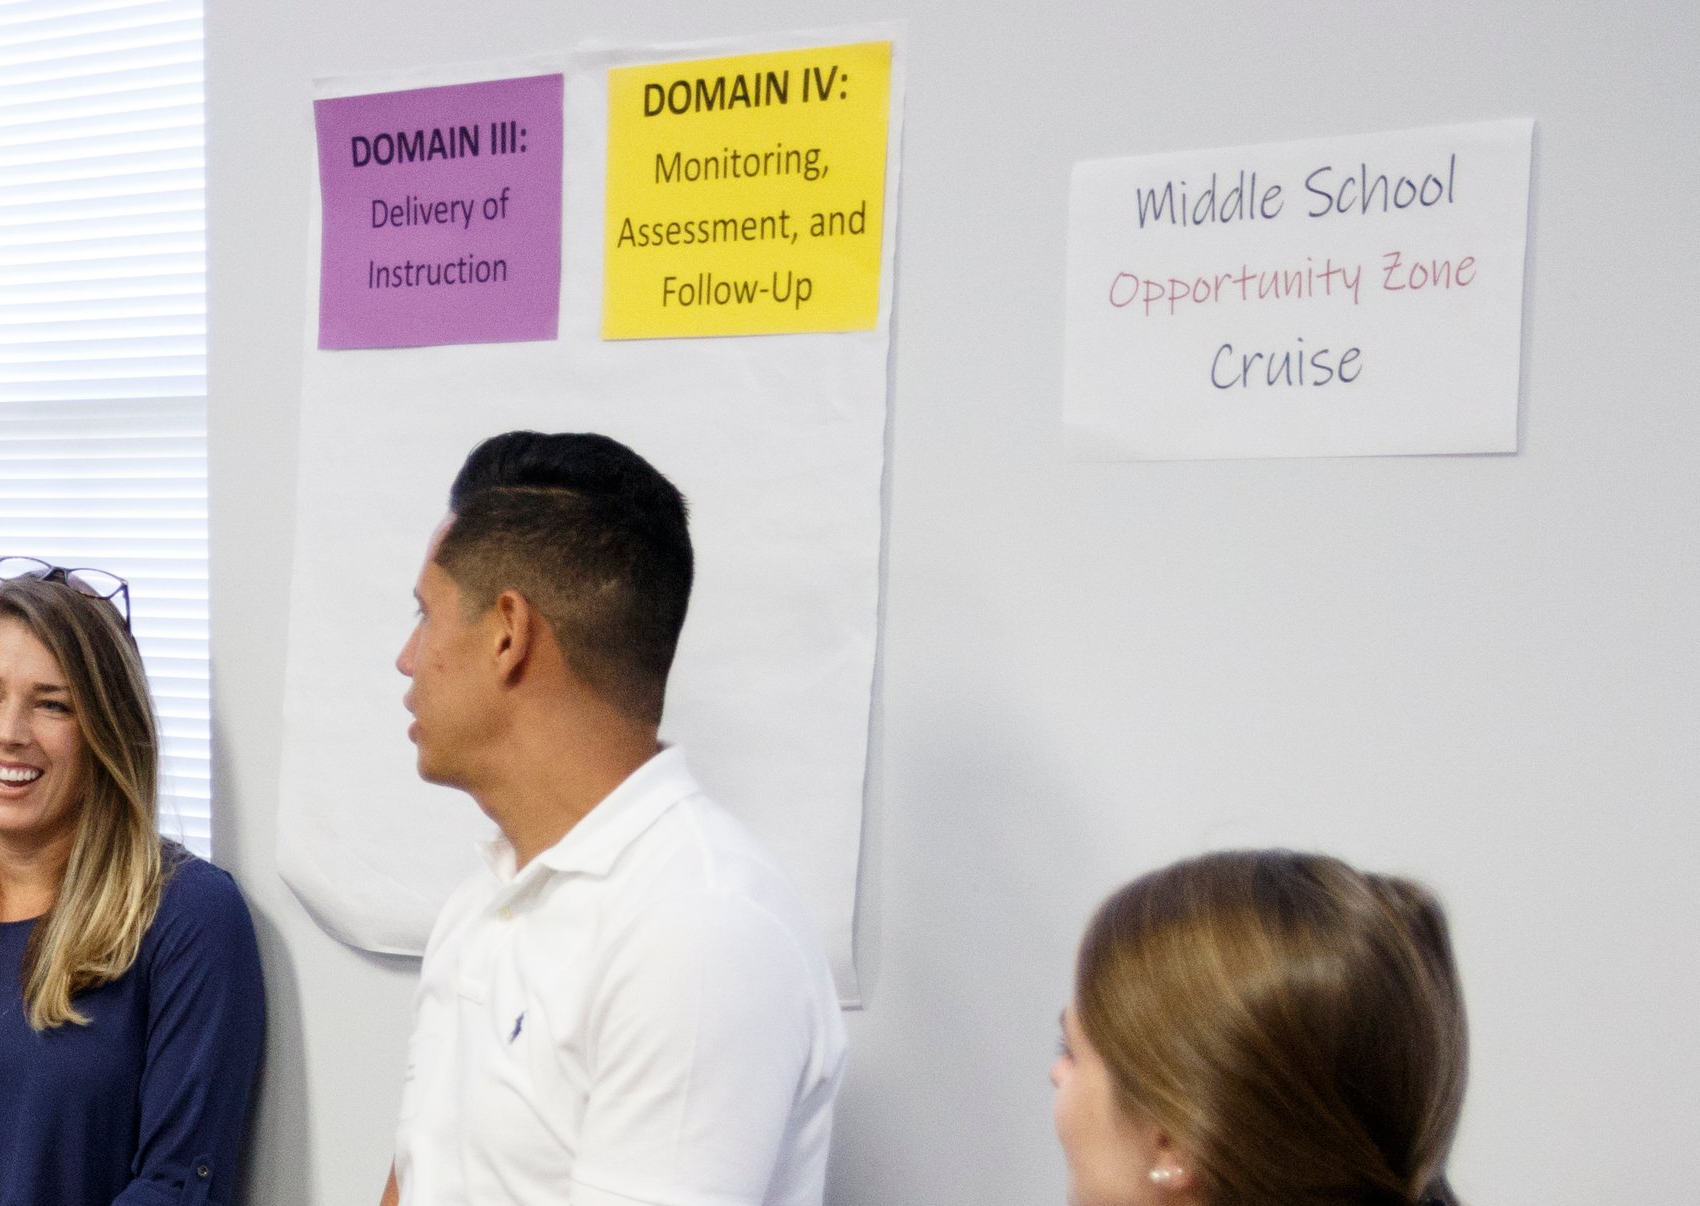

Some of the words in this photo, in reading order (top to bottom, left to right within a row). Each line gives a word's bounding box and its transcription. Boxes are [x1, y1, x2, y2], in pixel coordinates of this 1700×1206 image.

[643, 70, 790, 117] DOMAIN
[801, 64, 849, 104] IV:
[351, 124, 481, 168] DOMAIN
[489, 120, 529, 155] III:
[654, 143, 830, 184] Monitoring,
[370, 193, 474, 230] Delivery
[482, 187, 510, 220] of
[1135, 169, 1285, 229] Middle
[1304, 153, 1457, 218] School
[616, 209, 800, 250] Assessment,
[809, 200, 868, 238] and
[368, 254, 509, 290] Instruction
[661, 271, 814, 310] Follow-Up
[1108, 256, 1363, 317] Opportunity
[1382, 250, 1478, 292] Zone
[1210, 336, 1363, 390] Cruise
